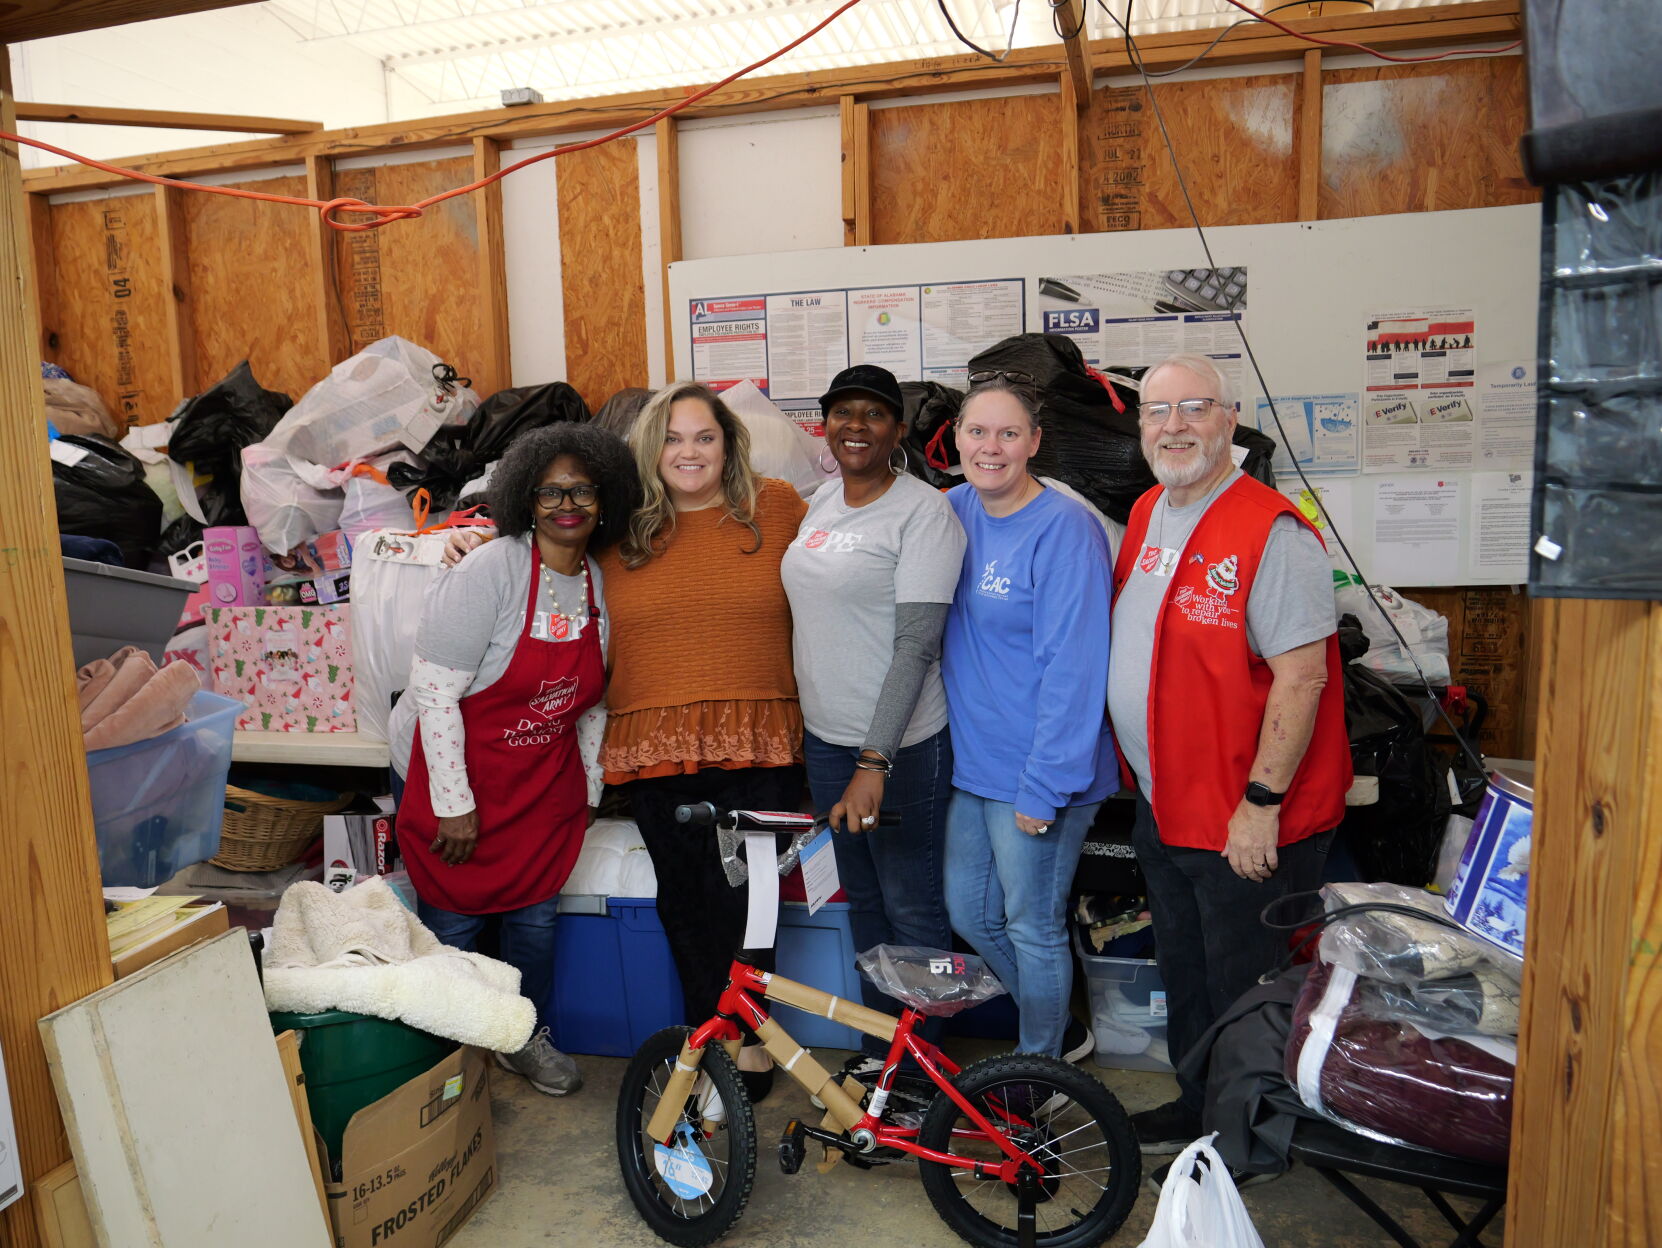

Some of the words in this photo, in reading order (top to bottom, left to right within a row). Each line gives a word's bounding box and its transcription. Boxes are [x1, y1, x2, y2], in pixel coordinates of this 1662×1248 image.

[790, 299, 804, 308] THE
[806, 298, 822, 307] LAW
[1048, 311, 1095, 328] FLSA
[698, 325, 733, 334] EMPLOYEE
[735, 323, 760, 332] RIGHTS
[1382, 402, 1407, 415] Verify
[1436, 400, 1462, 413] Verify
[785, 411, 814, 419] MPLOYEE
[982, 575, 1011, 595] CAC
[1192, 594, 1228, 607] Working
[1195, 603, 1215, 612] with
[1181, 606, 1190, 614] to
[1191, 608, 1219, 619] repair
[1187, 613, 1219, 626] broken
[1221, 618, 1238, 629] lives
[530, 683, 577, 706] SALVATION
[542, 694, 572, 713] ARMY
[508, 734, 551, 747] GOOD
[377, 832, 387, 875] Razor
[929, 957, 953, 975] 16
[351, 1168, 393, 1203] 16-13.5
[371, 1177, 447, 1248] FROSTED
[449, 1126, 483, 1186] FLAKES
